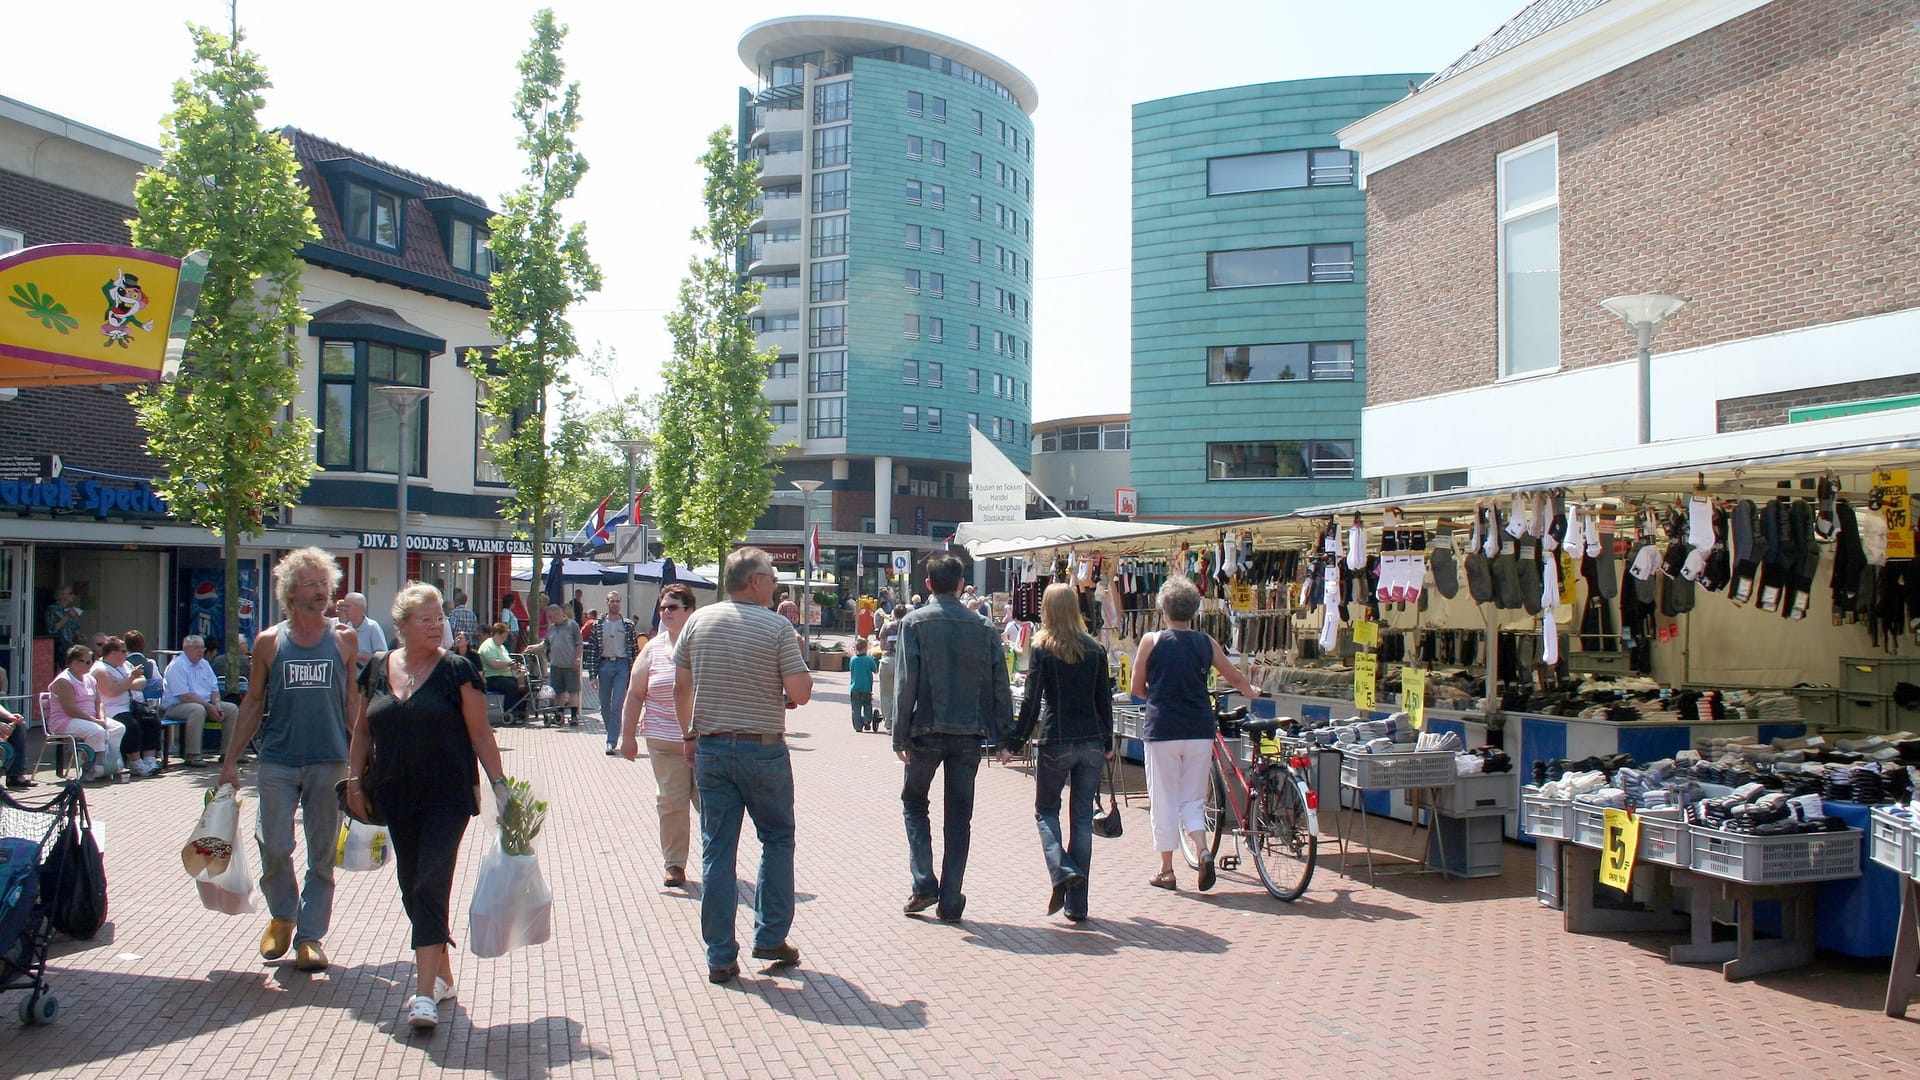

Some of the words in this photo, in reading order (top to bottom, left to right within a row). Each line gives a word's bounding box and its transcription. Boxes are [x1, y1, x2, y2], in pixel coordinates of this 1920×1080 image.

[0, 478, 73, 508] atiek
[84, 480, 168, 516] Specia
[363, 533, 388, 548] DIV.
[390, 535, 449, 551] BOODJES
[467, 539, 505, 553] WARME
[506, 541, 557, 555] GEBAKEN
[558, 543, 573, 555] VIS
[288, 662, 329, 684] EVERLAST
